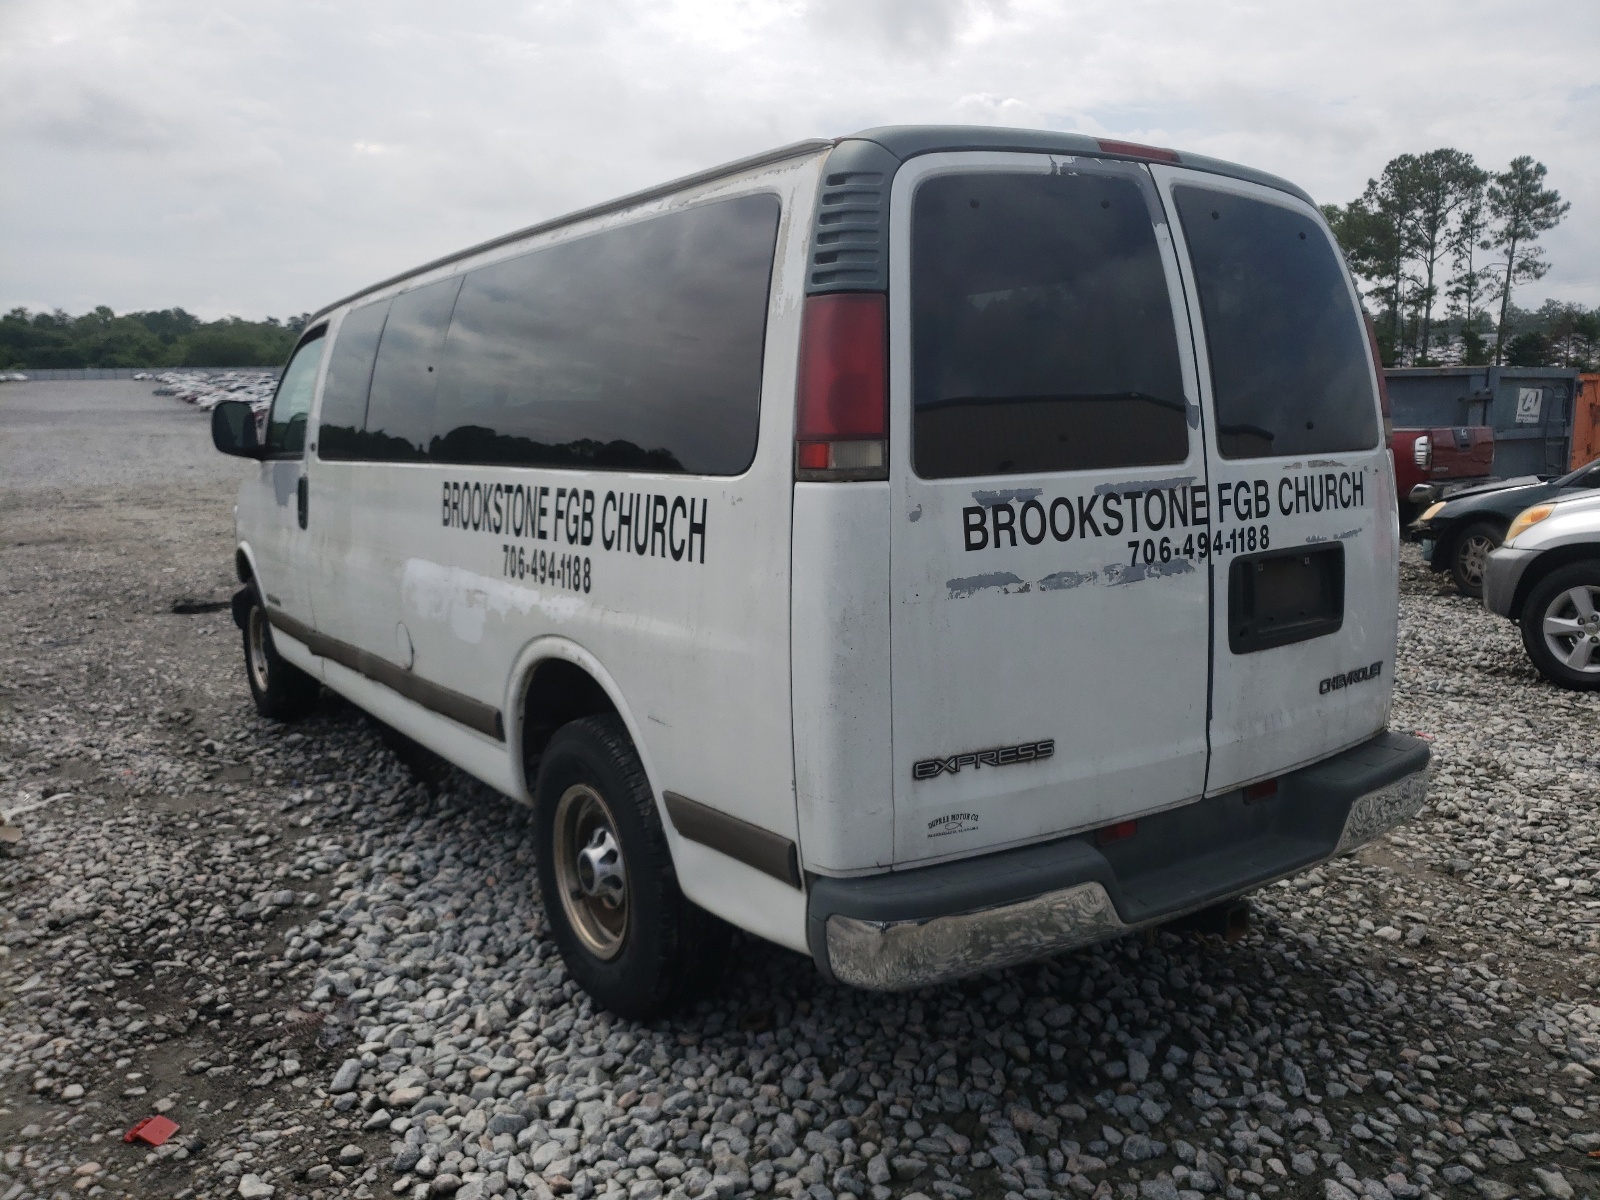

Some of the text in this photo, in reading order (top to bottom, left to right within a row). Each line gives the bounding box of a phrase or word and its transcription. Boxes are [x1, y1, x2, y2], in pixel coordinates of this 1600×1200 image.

[442, 481, 708, 564] BROOKSTONE FGB CHURCH
[963, 471, 1364, 552] BROOKSTONE FGB CHURCH
[503, 544, 592, 594] 706-494-1188
[1128, 525, 1270, 567] 706-494-1188
[1319, 661, 1383, 695] CHEVROLET
[913, 739, 1055, 780] EXPRESS
